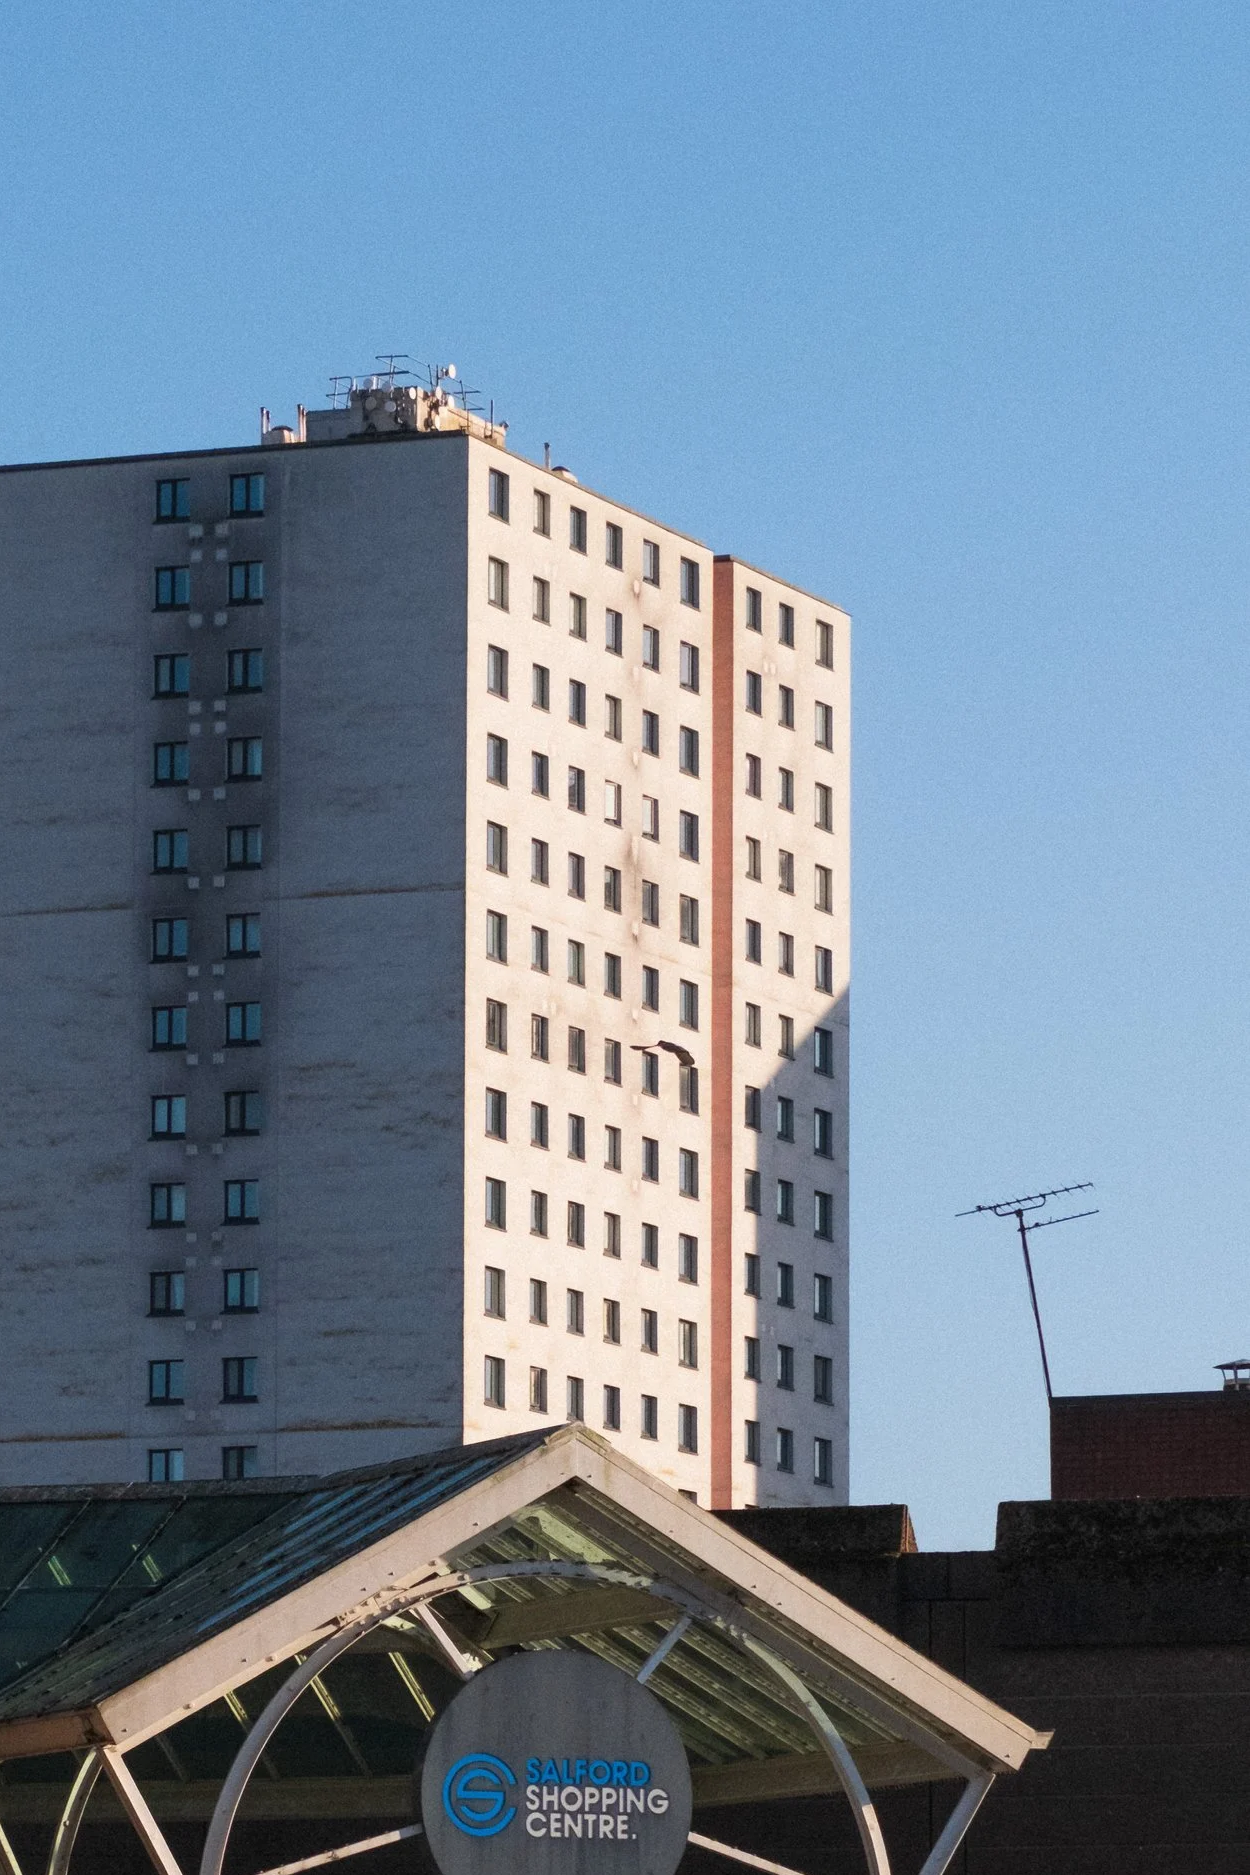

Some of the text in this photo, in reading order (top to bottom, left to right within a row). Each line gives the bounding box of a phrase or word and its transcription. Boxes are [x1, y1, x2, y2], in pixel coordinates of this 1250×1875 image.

[525, 1757, 650, 1786] SALFORD
[525, 1785, 669, 1814] SHOPPING
[525, 1812, 637, 1840] CENTRE.
